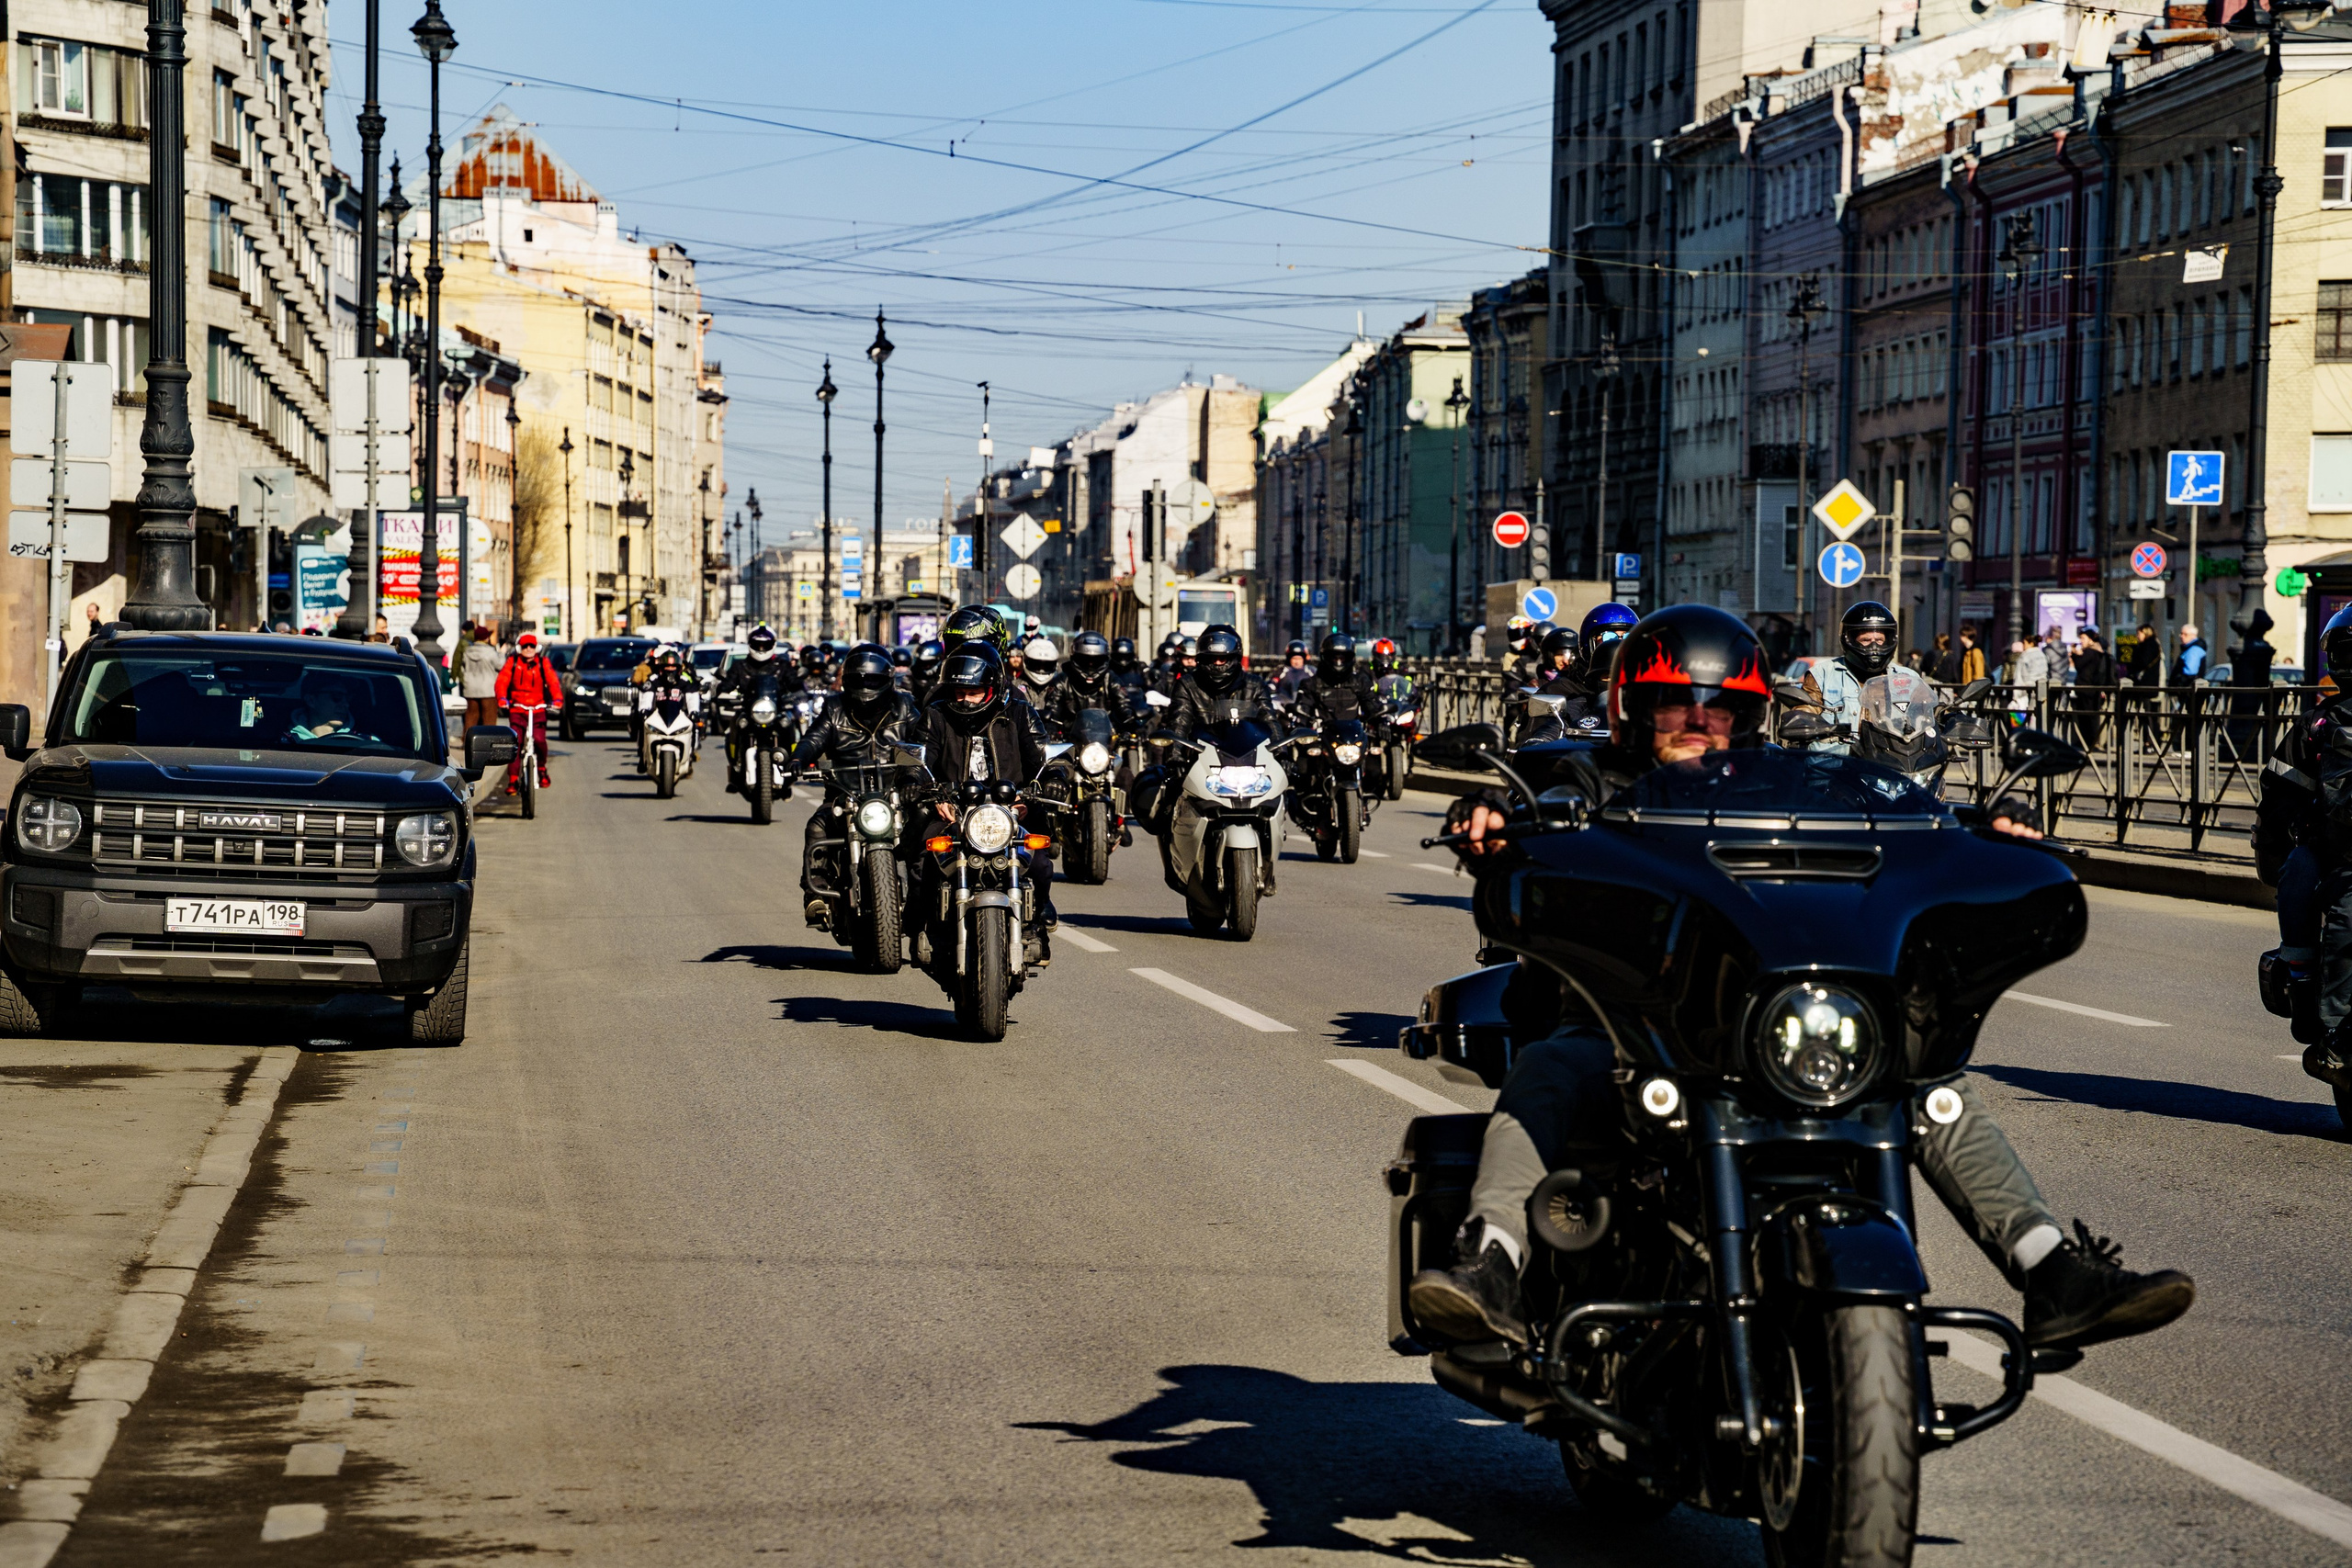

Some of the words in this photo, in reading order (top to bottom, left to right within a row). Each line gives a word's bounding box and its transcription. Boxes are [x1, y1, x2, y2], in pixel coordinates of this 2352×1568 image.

[380, 517, 452, 534] ТКАИ
[203, 816, 277, 828] HAVAL
[266, 904, 299, 920] 198
